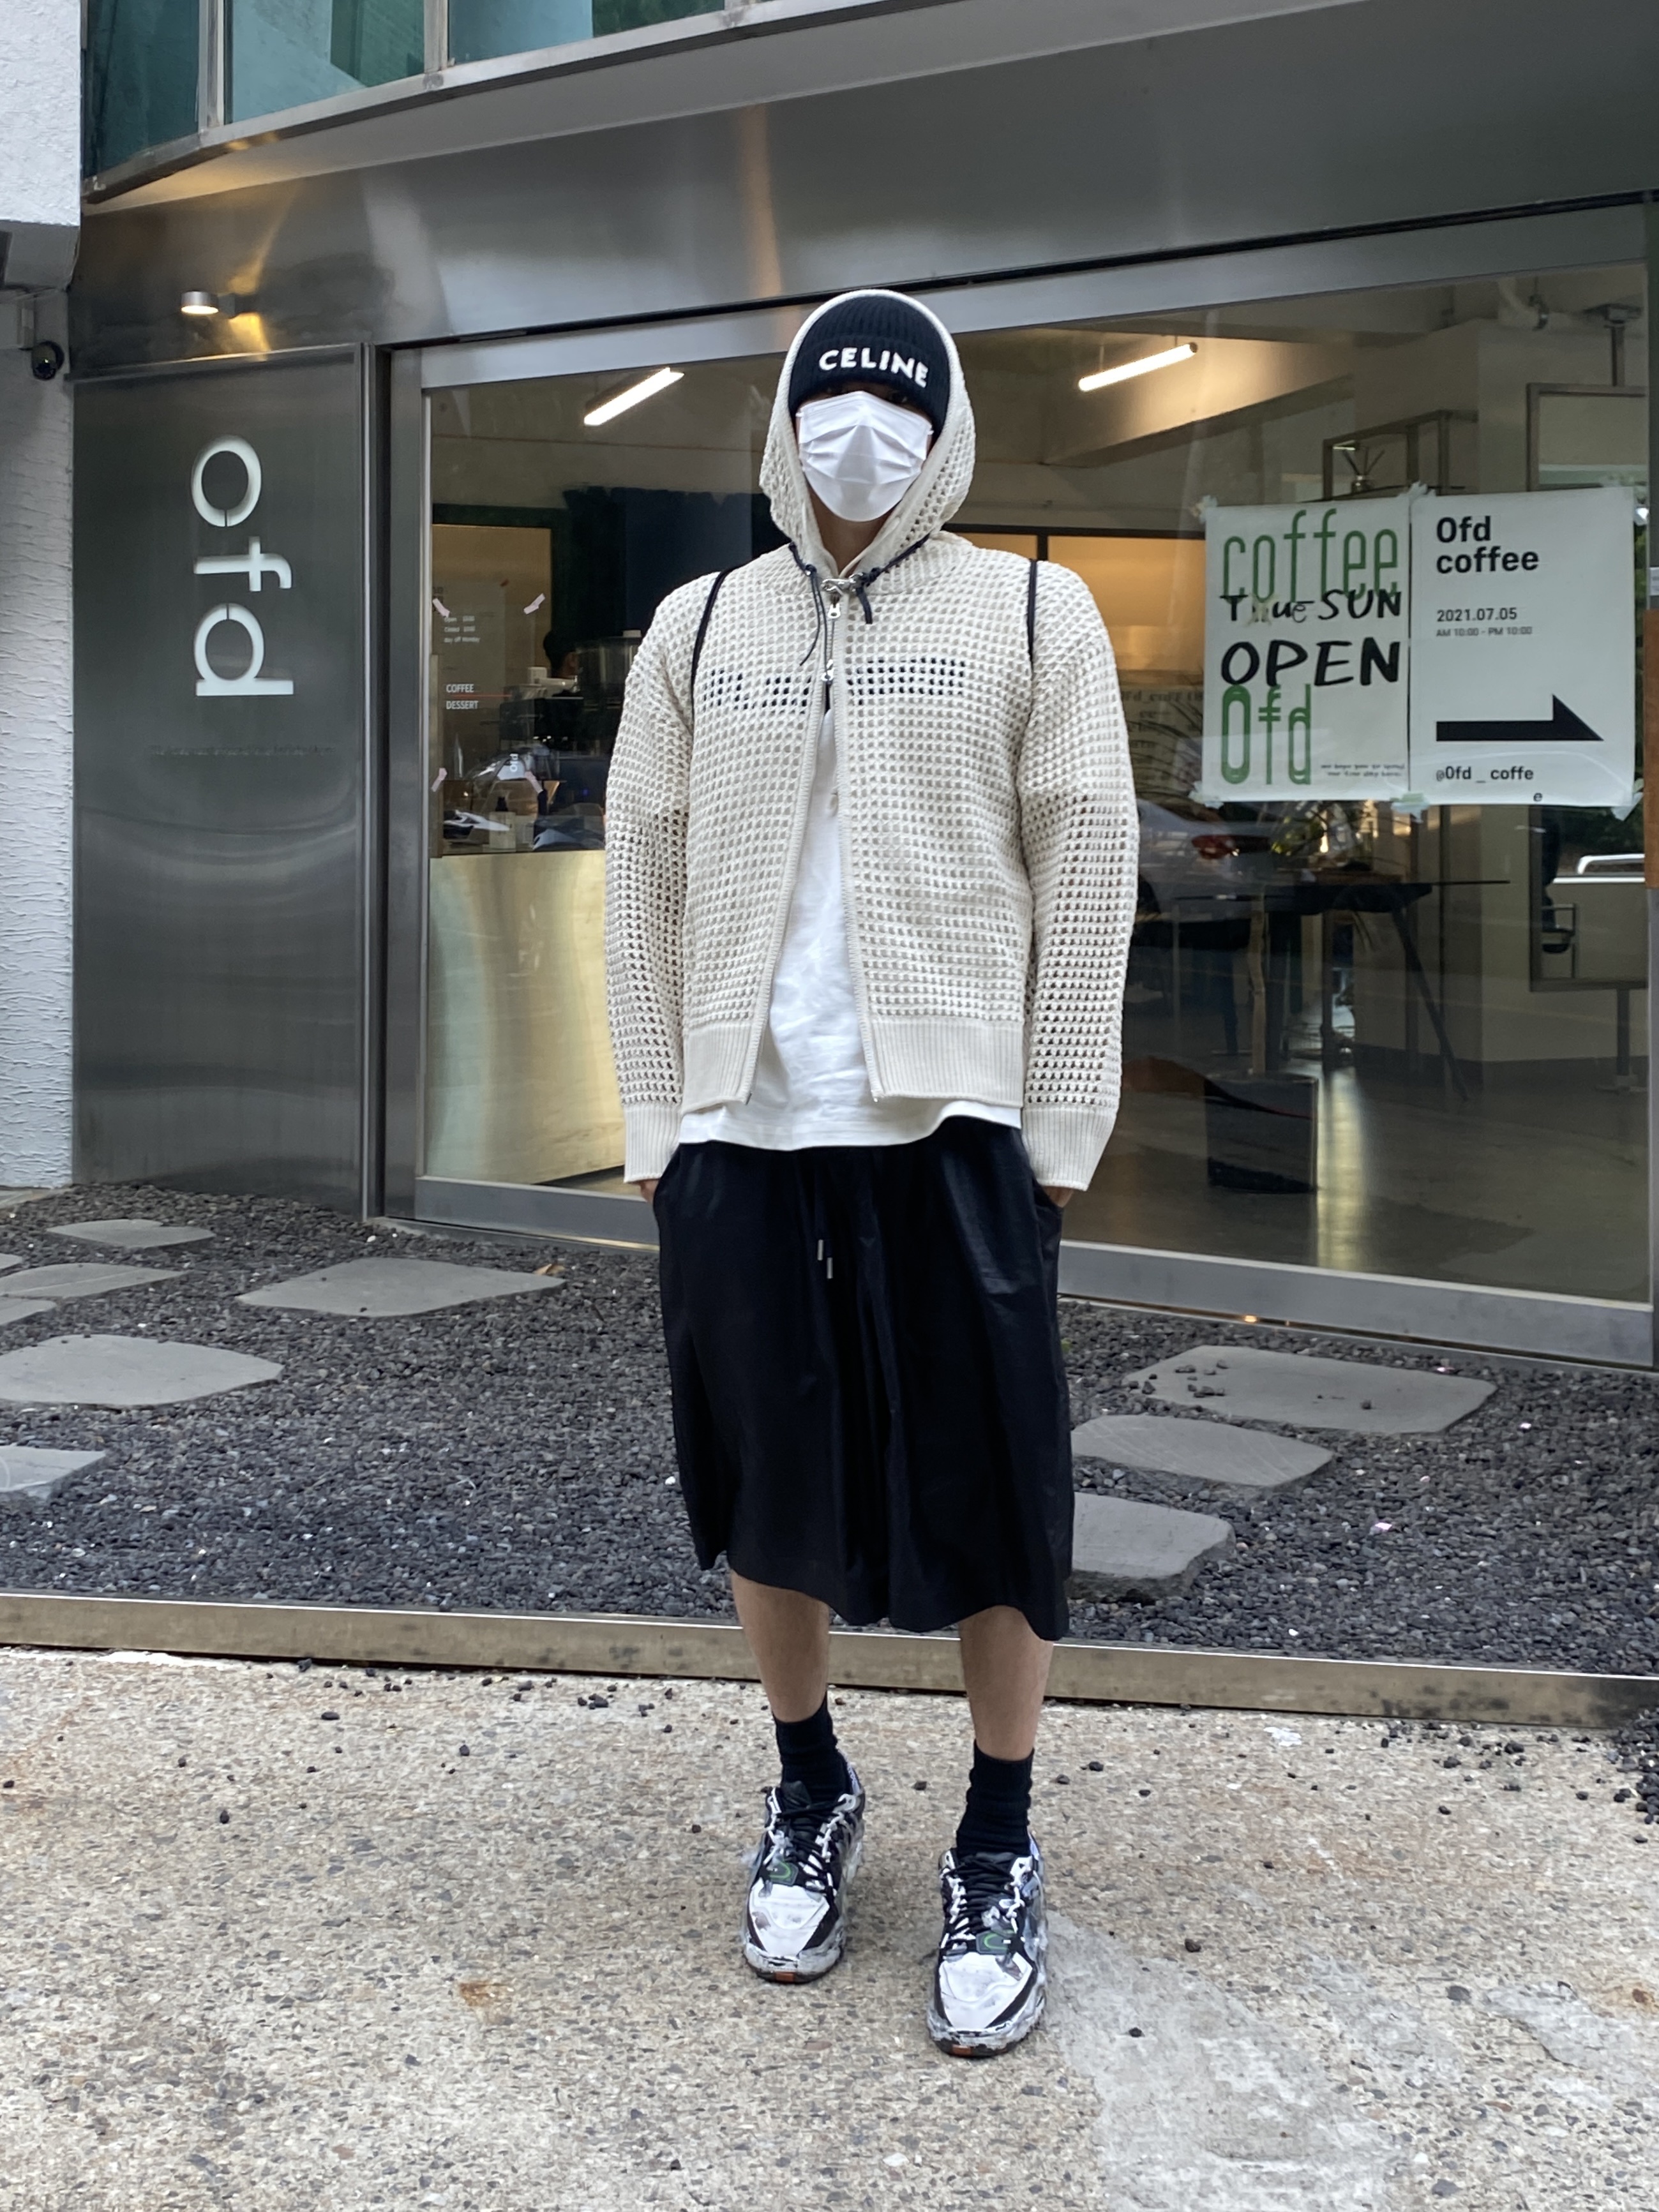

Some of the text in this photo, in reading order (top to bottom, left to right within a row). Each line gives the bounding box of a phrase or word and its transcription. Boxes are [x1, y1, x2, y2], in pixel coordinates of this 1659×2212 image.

[819, 347, 928, 388] CELINE
[1224, 509, 1397, 605] coffee
[1437, 546, 1538, 573] coffee
[1437, 607, 1517, 622] 2021.07.05
[1221, 637, 1400, 687] OPEN
[446, 684, 474, 692] COFFEE
[446, 701, 478, 709] DESSERT
